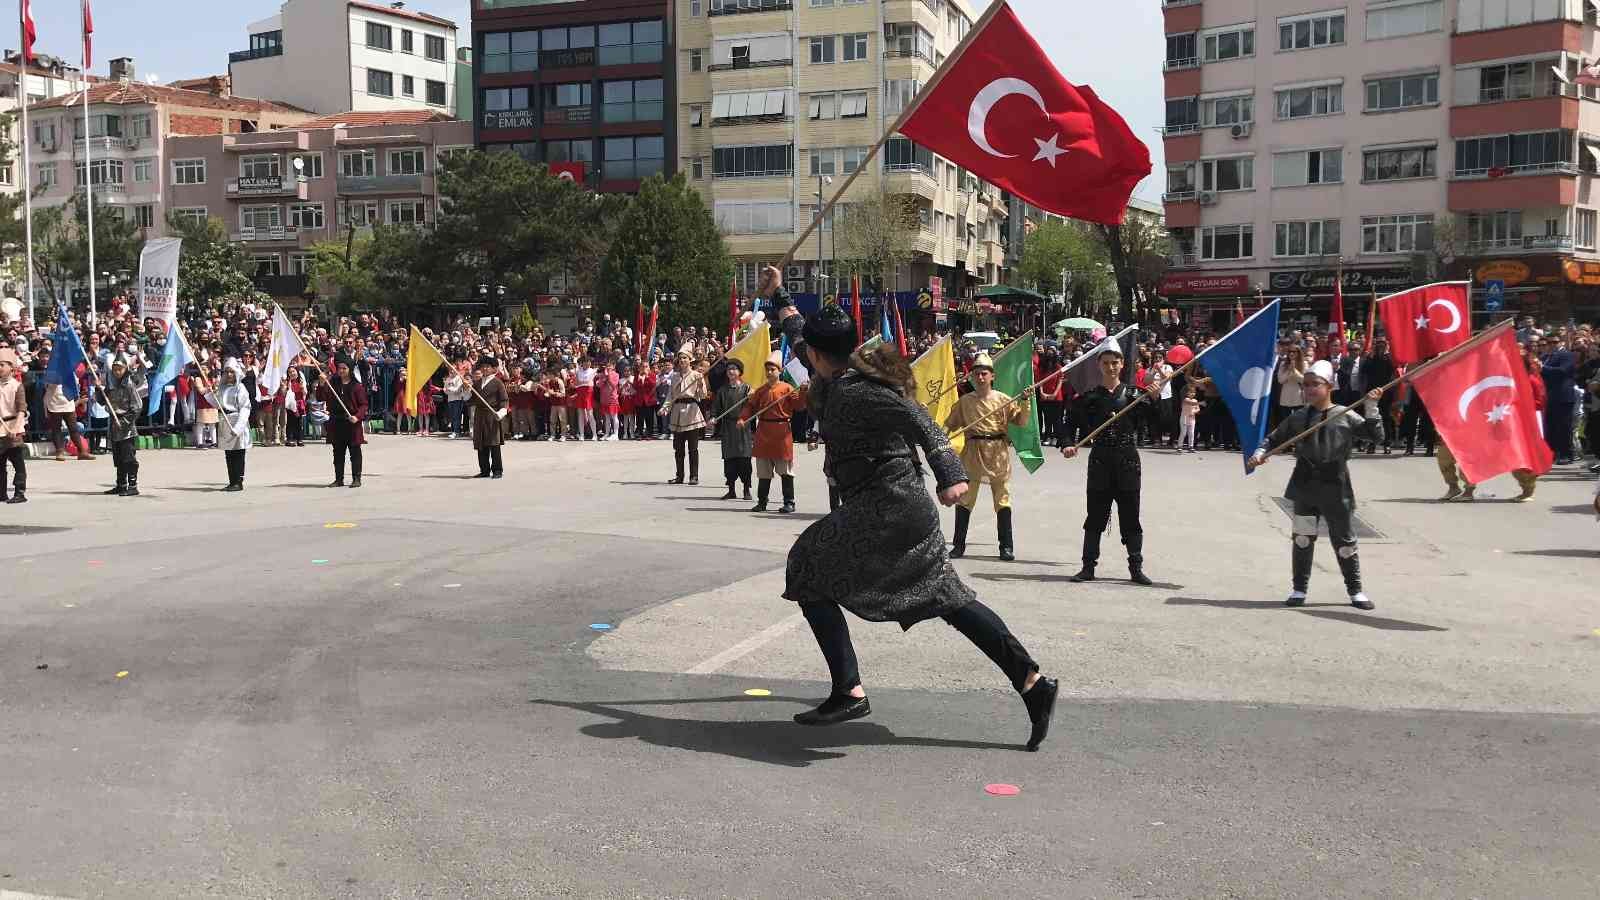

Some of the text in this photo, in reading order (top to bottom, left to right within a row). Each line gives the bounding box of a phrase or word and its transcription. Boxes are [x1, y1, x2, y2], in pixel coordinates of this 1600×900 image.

[498, 118, 533, 128] EMLAK
[144, 276, 173, 288] KAN
[1187, 279, 1219, 288] MEYDAN
[1220, 278, 1240, 287] GIDA
[1352, 271, 1361, 285] 2
